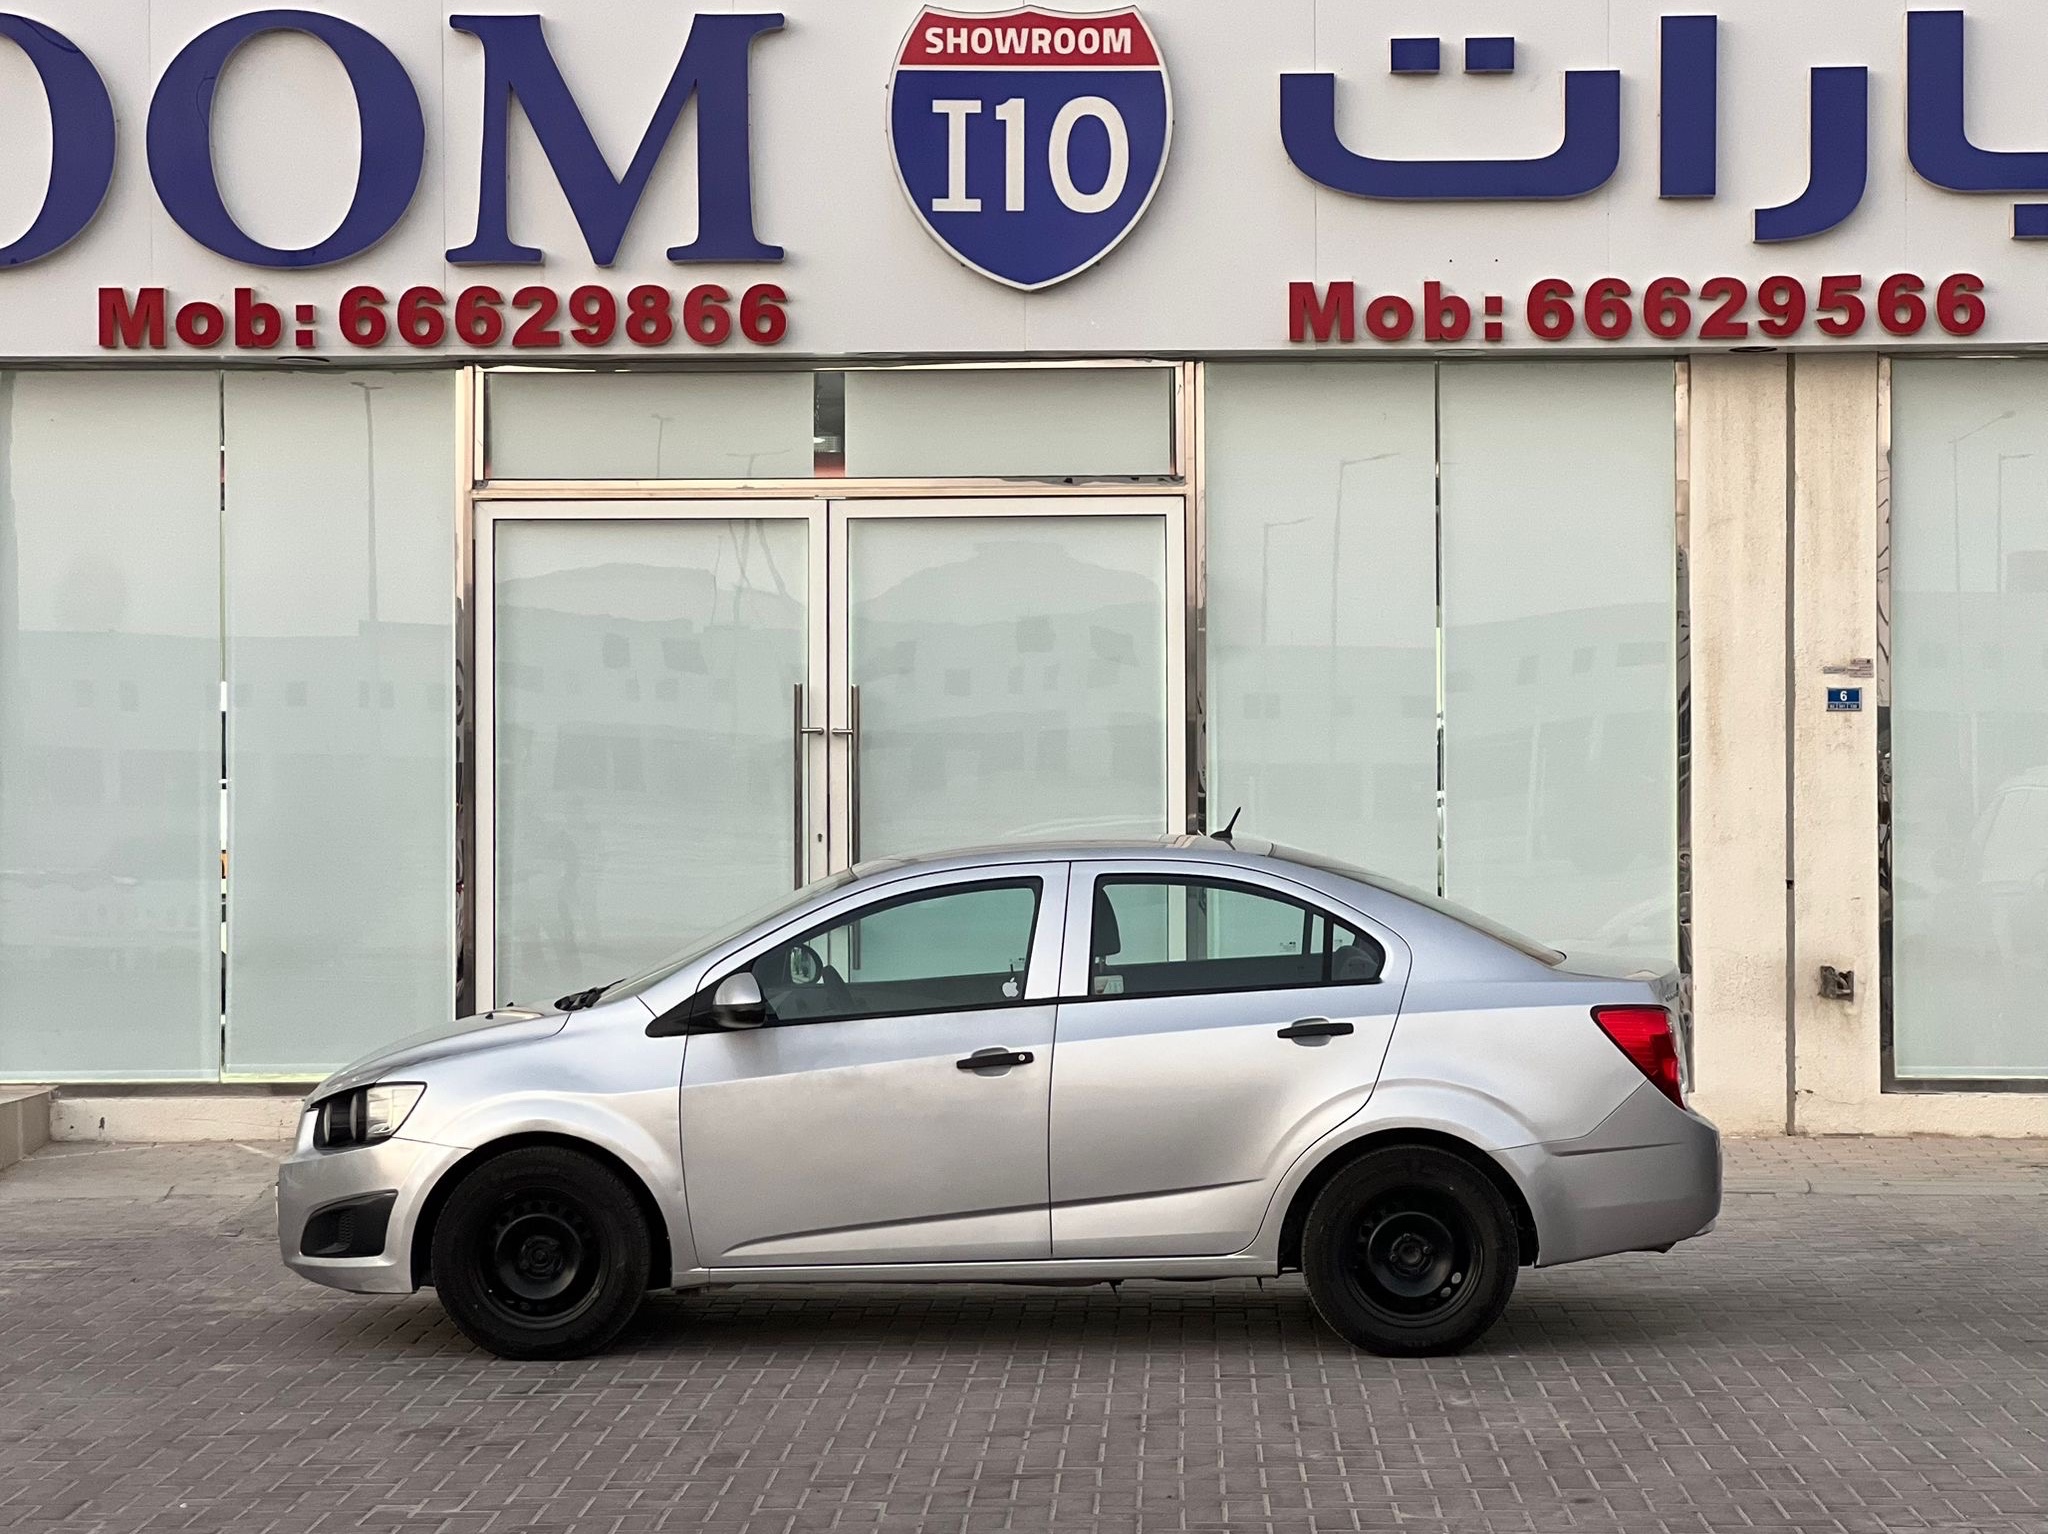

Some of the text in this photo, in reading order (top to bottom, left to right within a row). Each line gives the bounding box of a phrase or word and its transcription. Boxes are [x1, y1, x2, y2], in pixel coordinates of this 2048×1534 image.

[925, 27, 1132, 54] SHOWROOM
[931, 96, 1130, 214] I10
[1280, 10, 2048, 243] ارات
[97, 283, 788, 349] Mob: 66629866
[1288, 273, 1987, 343] Mob: 66629566
[1840, 690, 1848, 702] 6
